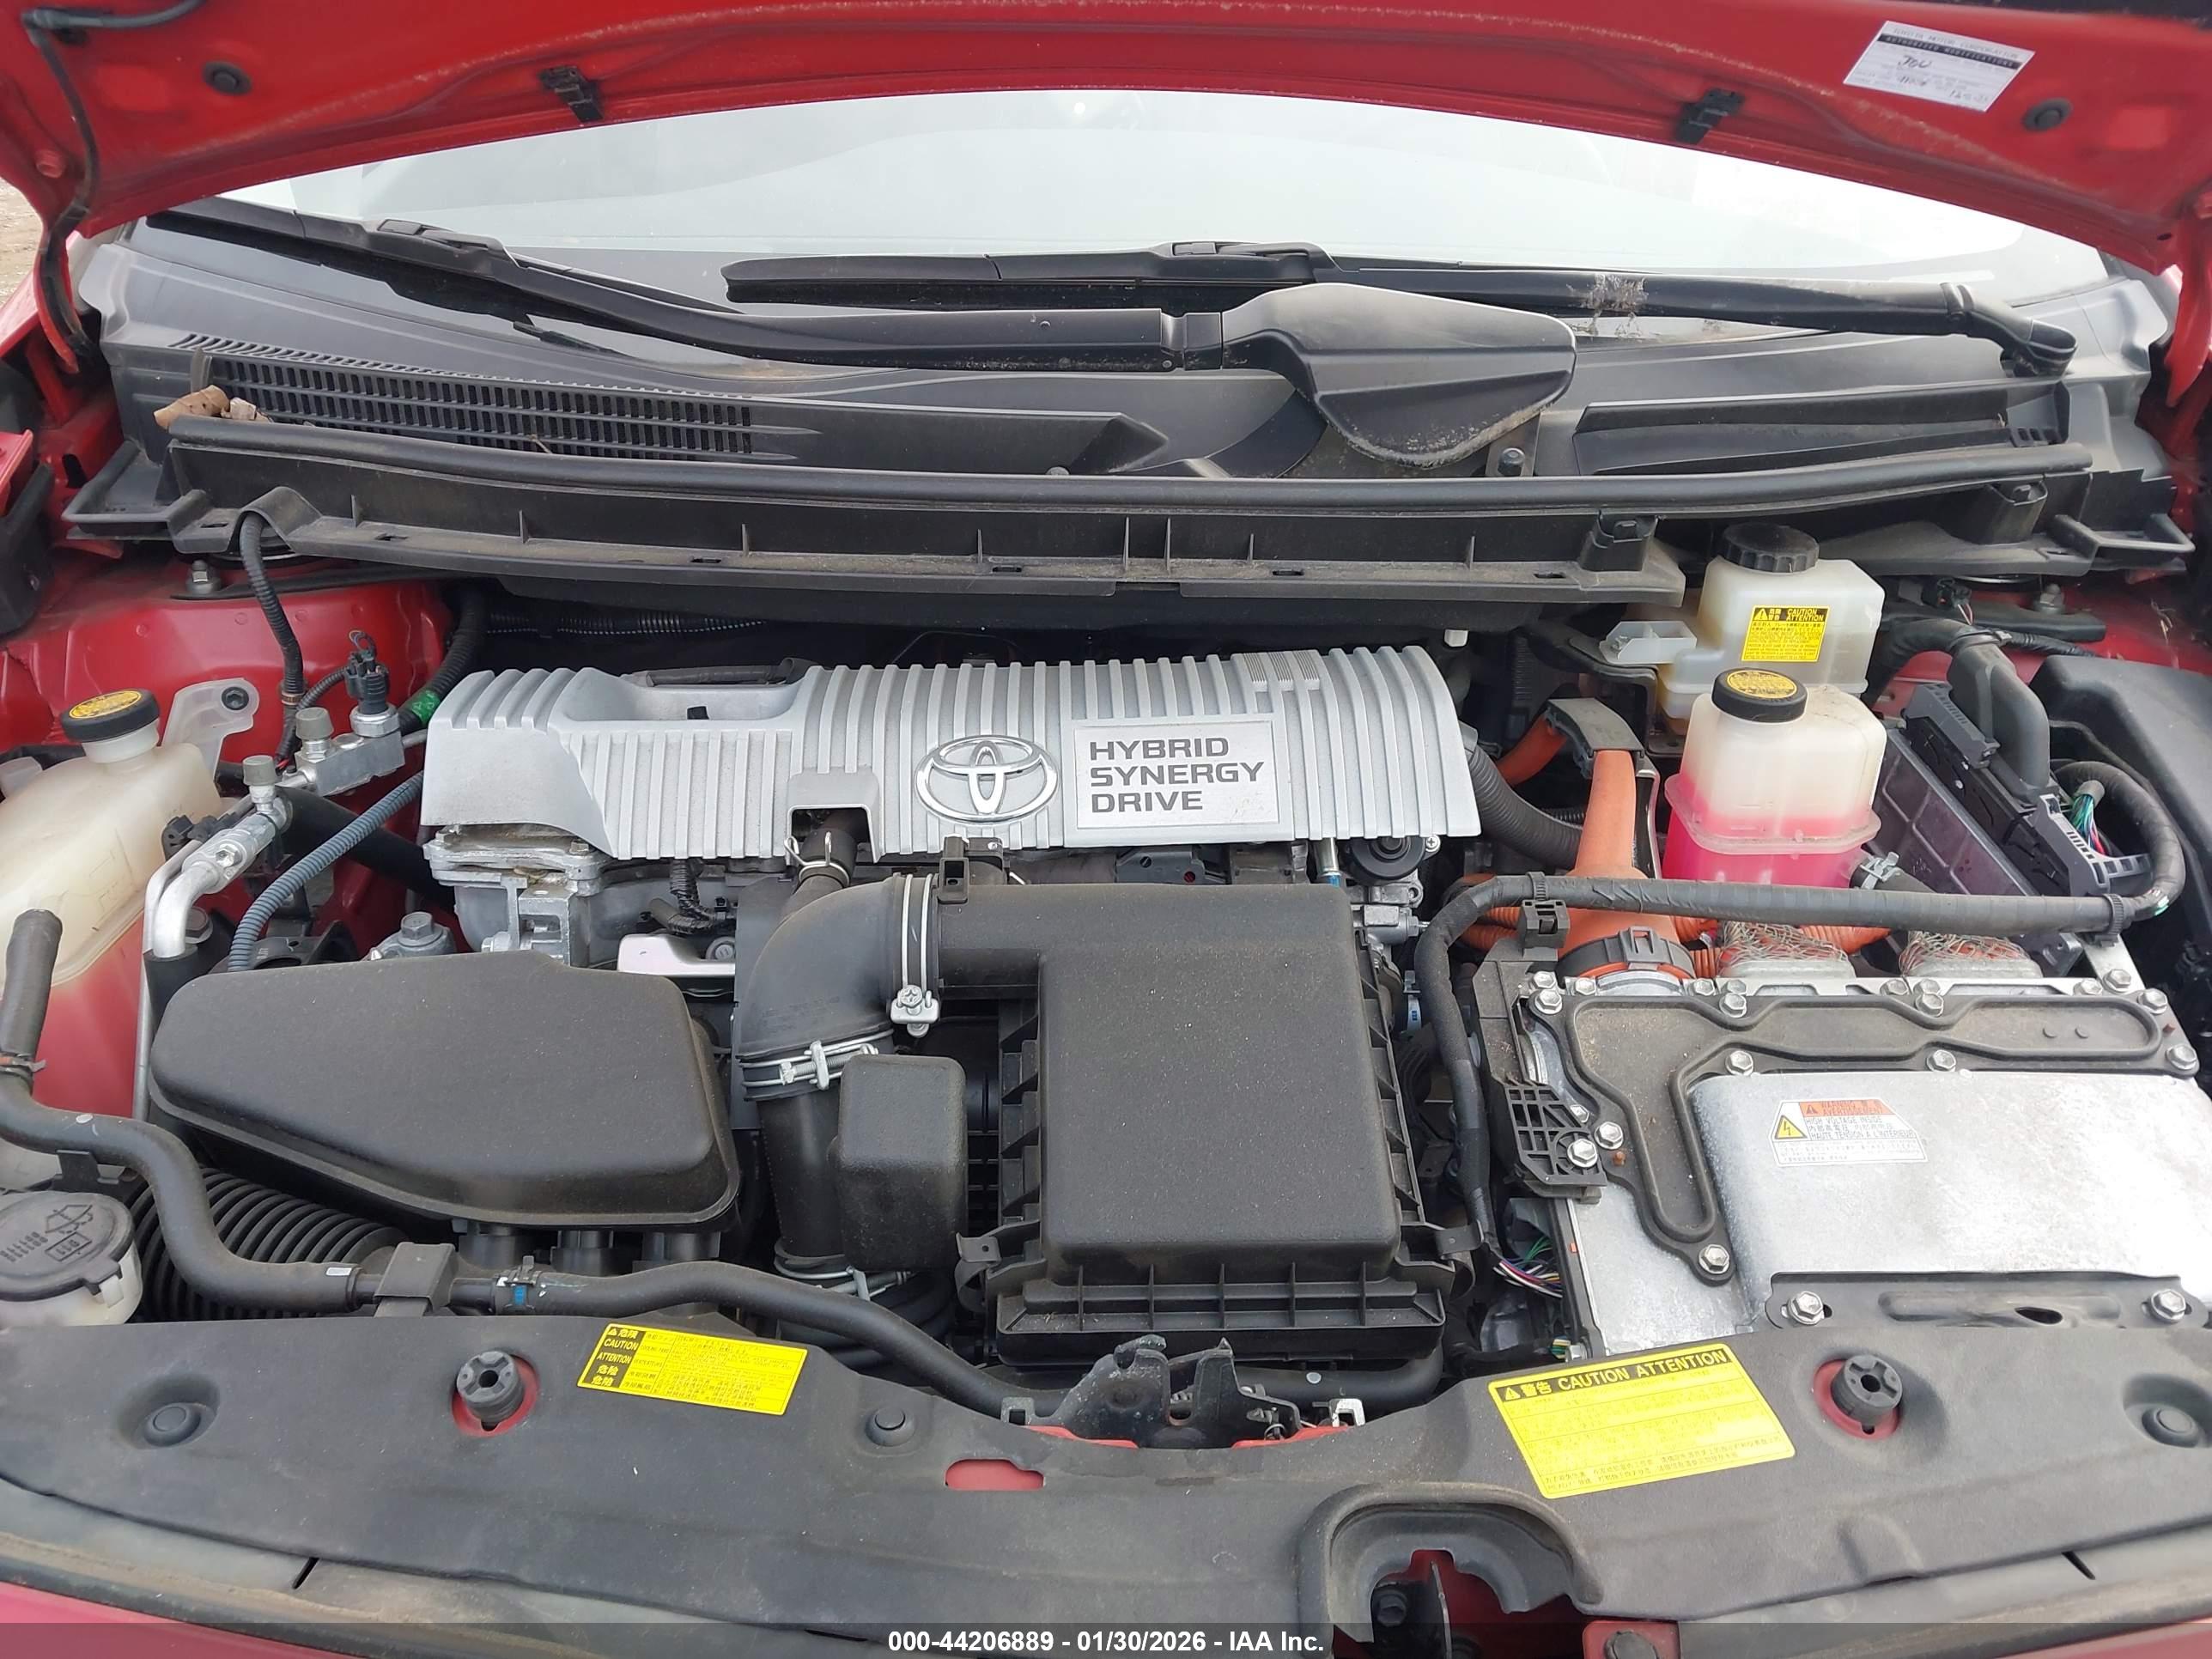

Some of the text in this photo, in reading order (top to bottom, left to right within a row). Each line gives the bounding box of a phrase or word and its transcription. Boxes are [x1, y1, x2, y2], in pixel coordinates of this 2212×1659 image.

[1090, 737, 1229, 760] HYBRID
[1090, 762, 1264, 787] SYNERGY
[1091, 790, 1204, 813] DRIVE
[604, 1338, 639, 1351] CAUTION
[596, 1352, 631, 1364] ATTENTION
[1559, 1367, 1630, 1391] CAUTION
[1637, 1350, 1728, 1379] ATTENTION
